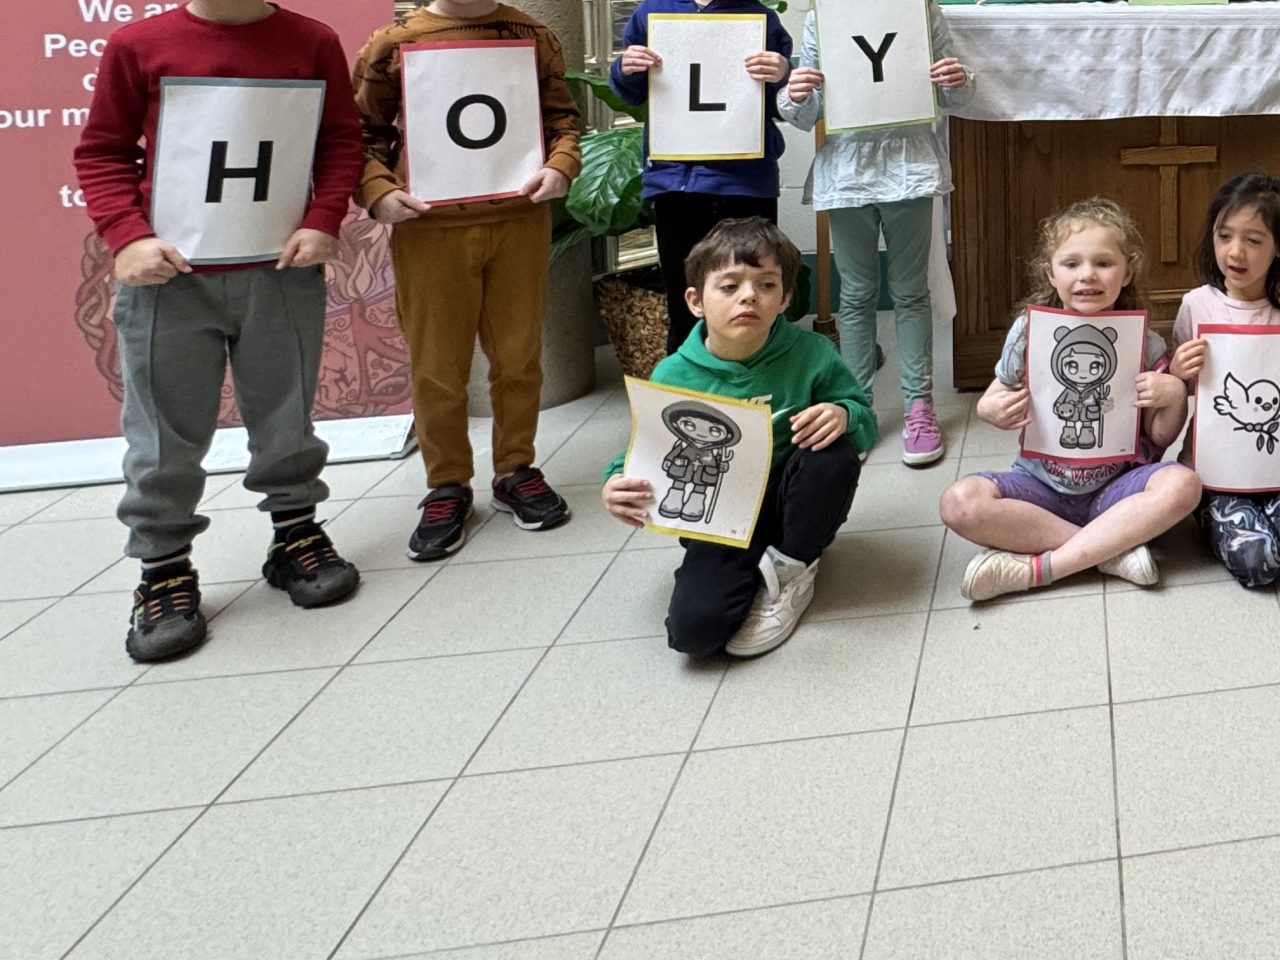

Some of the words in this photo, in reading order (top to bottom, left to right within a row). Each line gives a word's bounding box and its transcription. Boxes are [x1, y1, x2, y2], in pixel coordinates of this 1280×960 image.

[852, 32, 898, 83] Y
[688, 62, 727, 112] L
[446, 93, 507, 150] O
[204, 140, 274, 203] H
